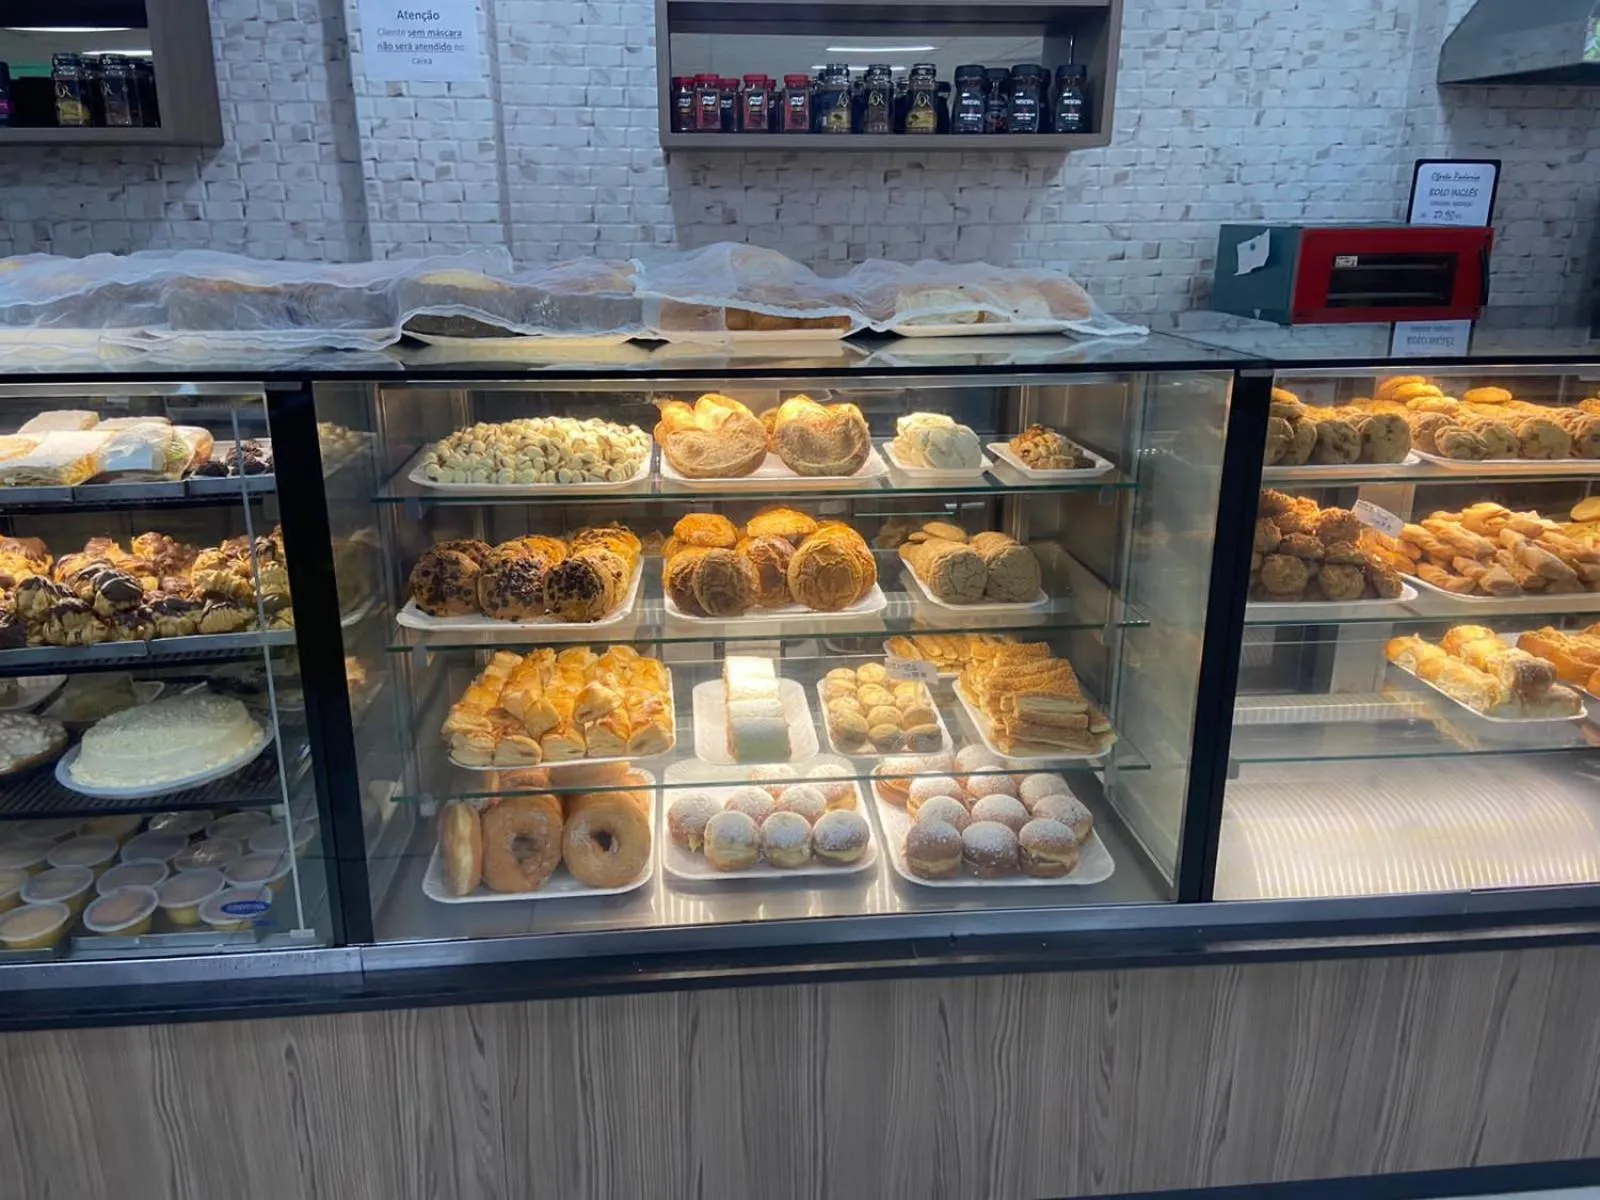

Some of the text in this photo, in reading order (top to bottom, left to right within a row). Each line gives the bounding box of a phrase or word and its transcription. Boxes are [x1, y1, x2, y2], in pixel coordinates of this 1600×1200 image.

[397, 9, 440, 21] Atenção
[427, 28, 462, 38] máscara
[377, 42, 393, 50] não
[395, 42, 412, 50] será
[415, 42, 452, 51] atendido
